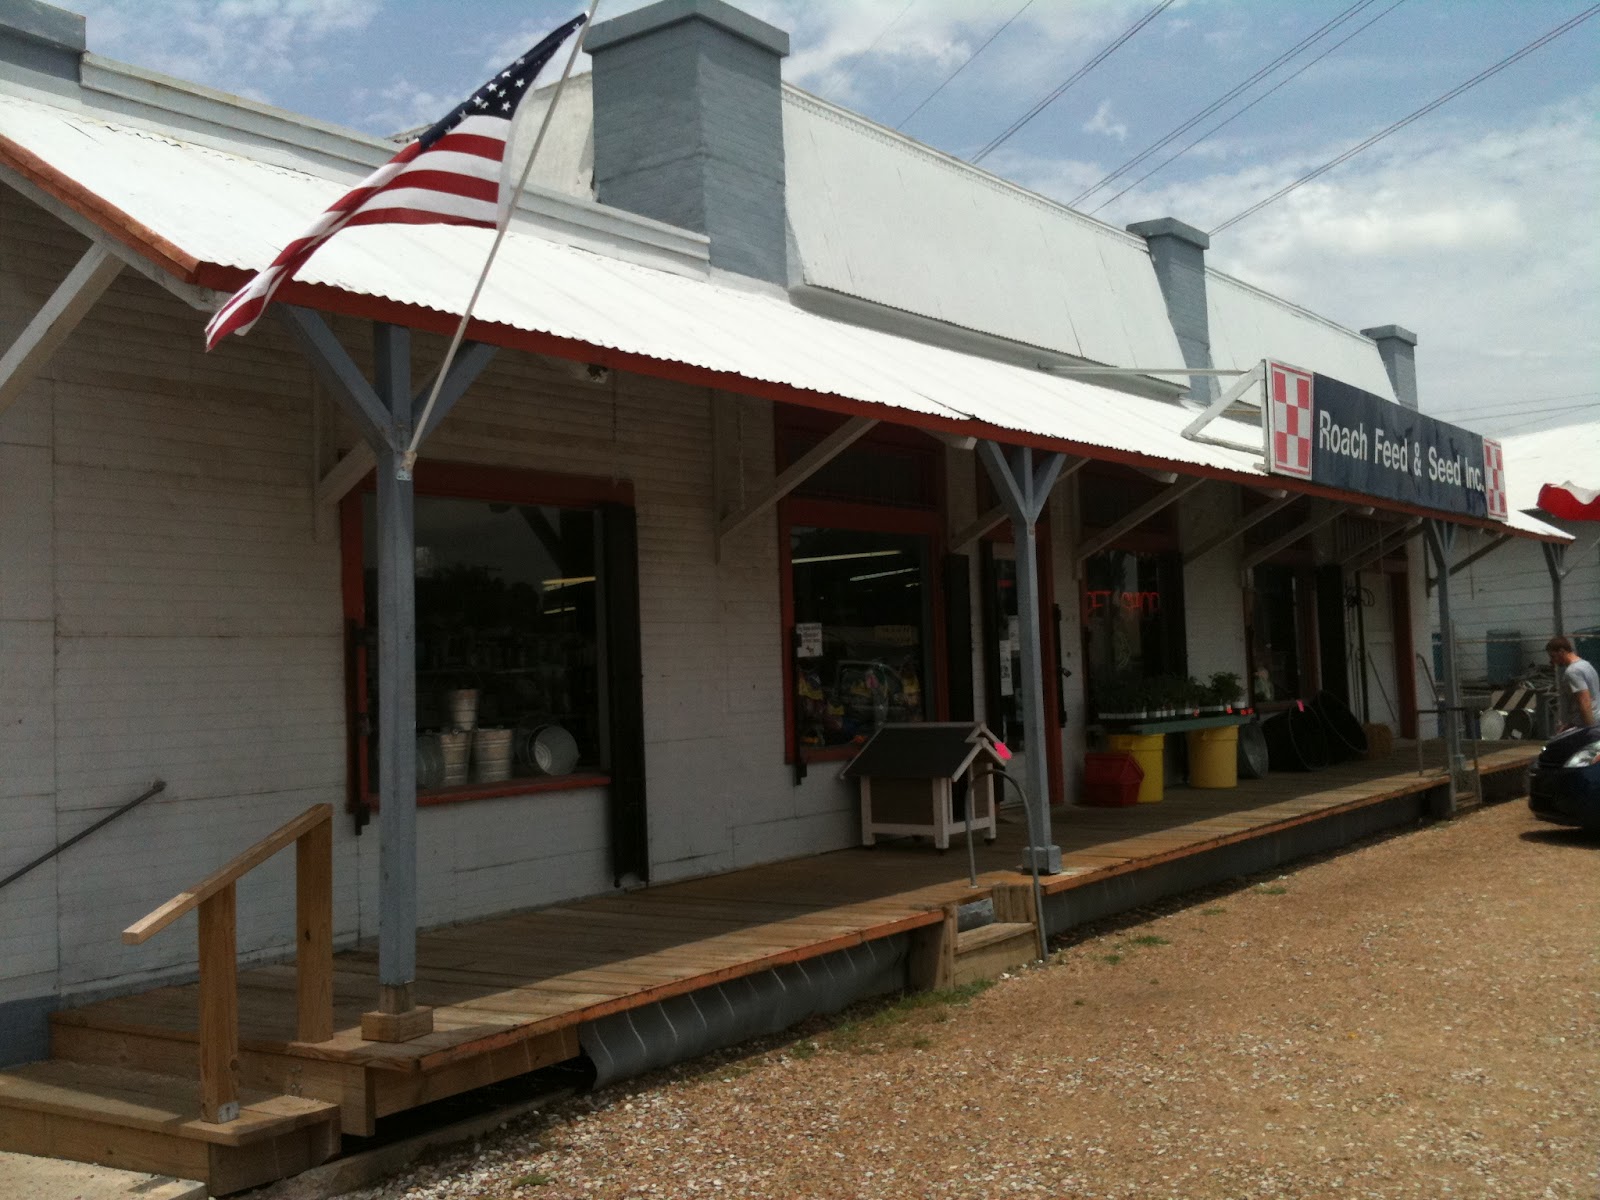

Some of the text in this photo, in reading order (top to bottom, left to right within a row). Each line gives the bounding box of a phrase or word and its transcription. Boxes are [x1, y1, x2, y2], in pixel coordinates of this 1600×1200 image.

[1320, 410, 1485, 491] Roach Feed & Seed Inc.
